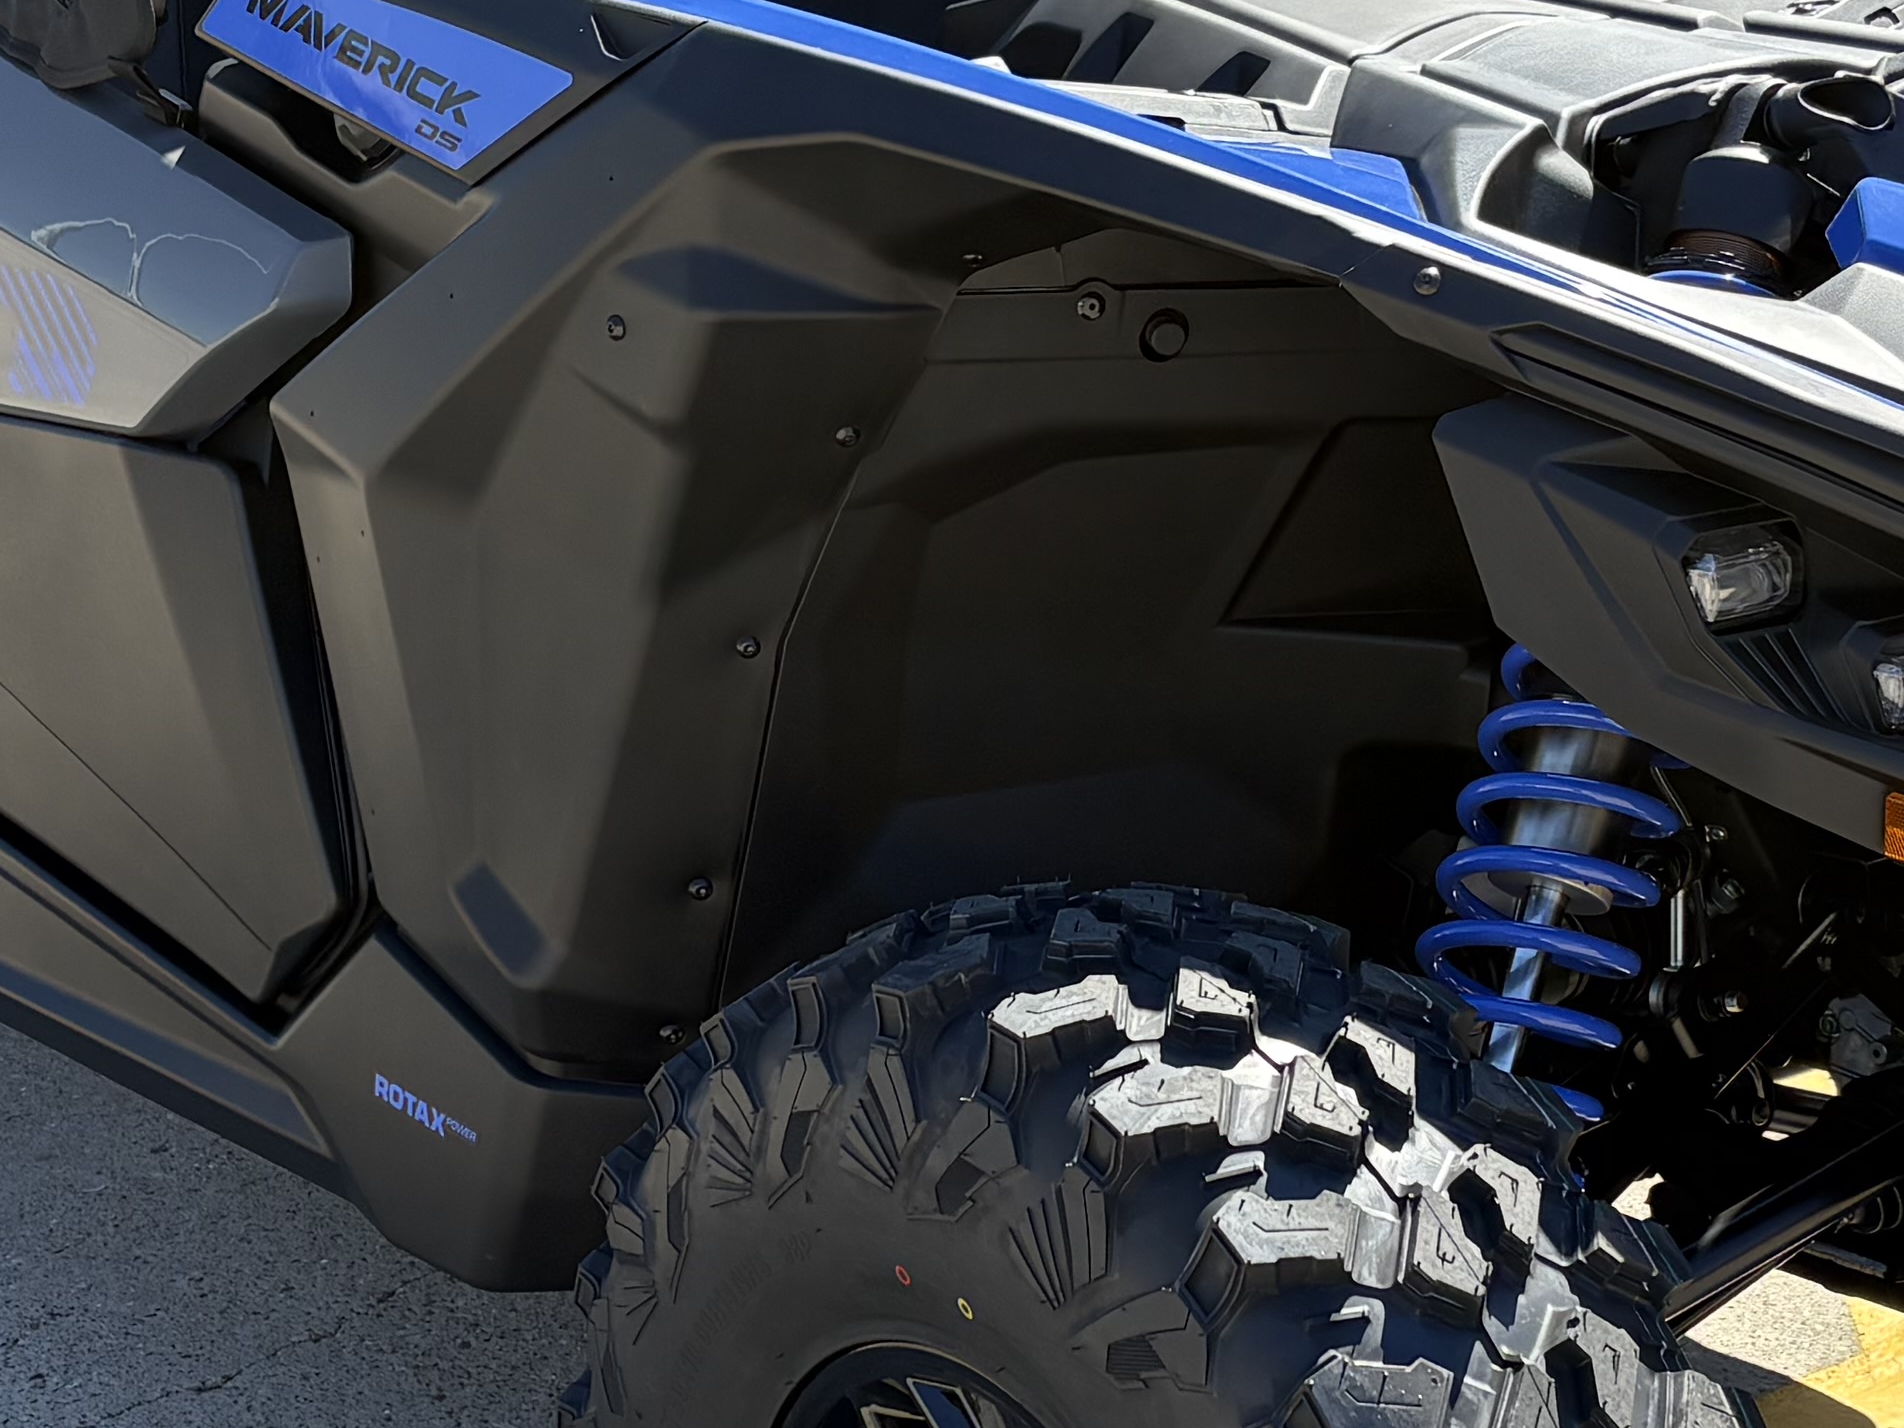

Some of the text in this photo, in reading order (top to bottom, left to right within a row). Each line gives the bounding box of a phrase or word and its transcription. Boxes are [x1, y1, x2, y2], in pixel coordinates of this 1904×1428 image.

[414, 117, 463, 153] DS
[373, 1072, 477, 1143] ROTAX POWER
